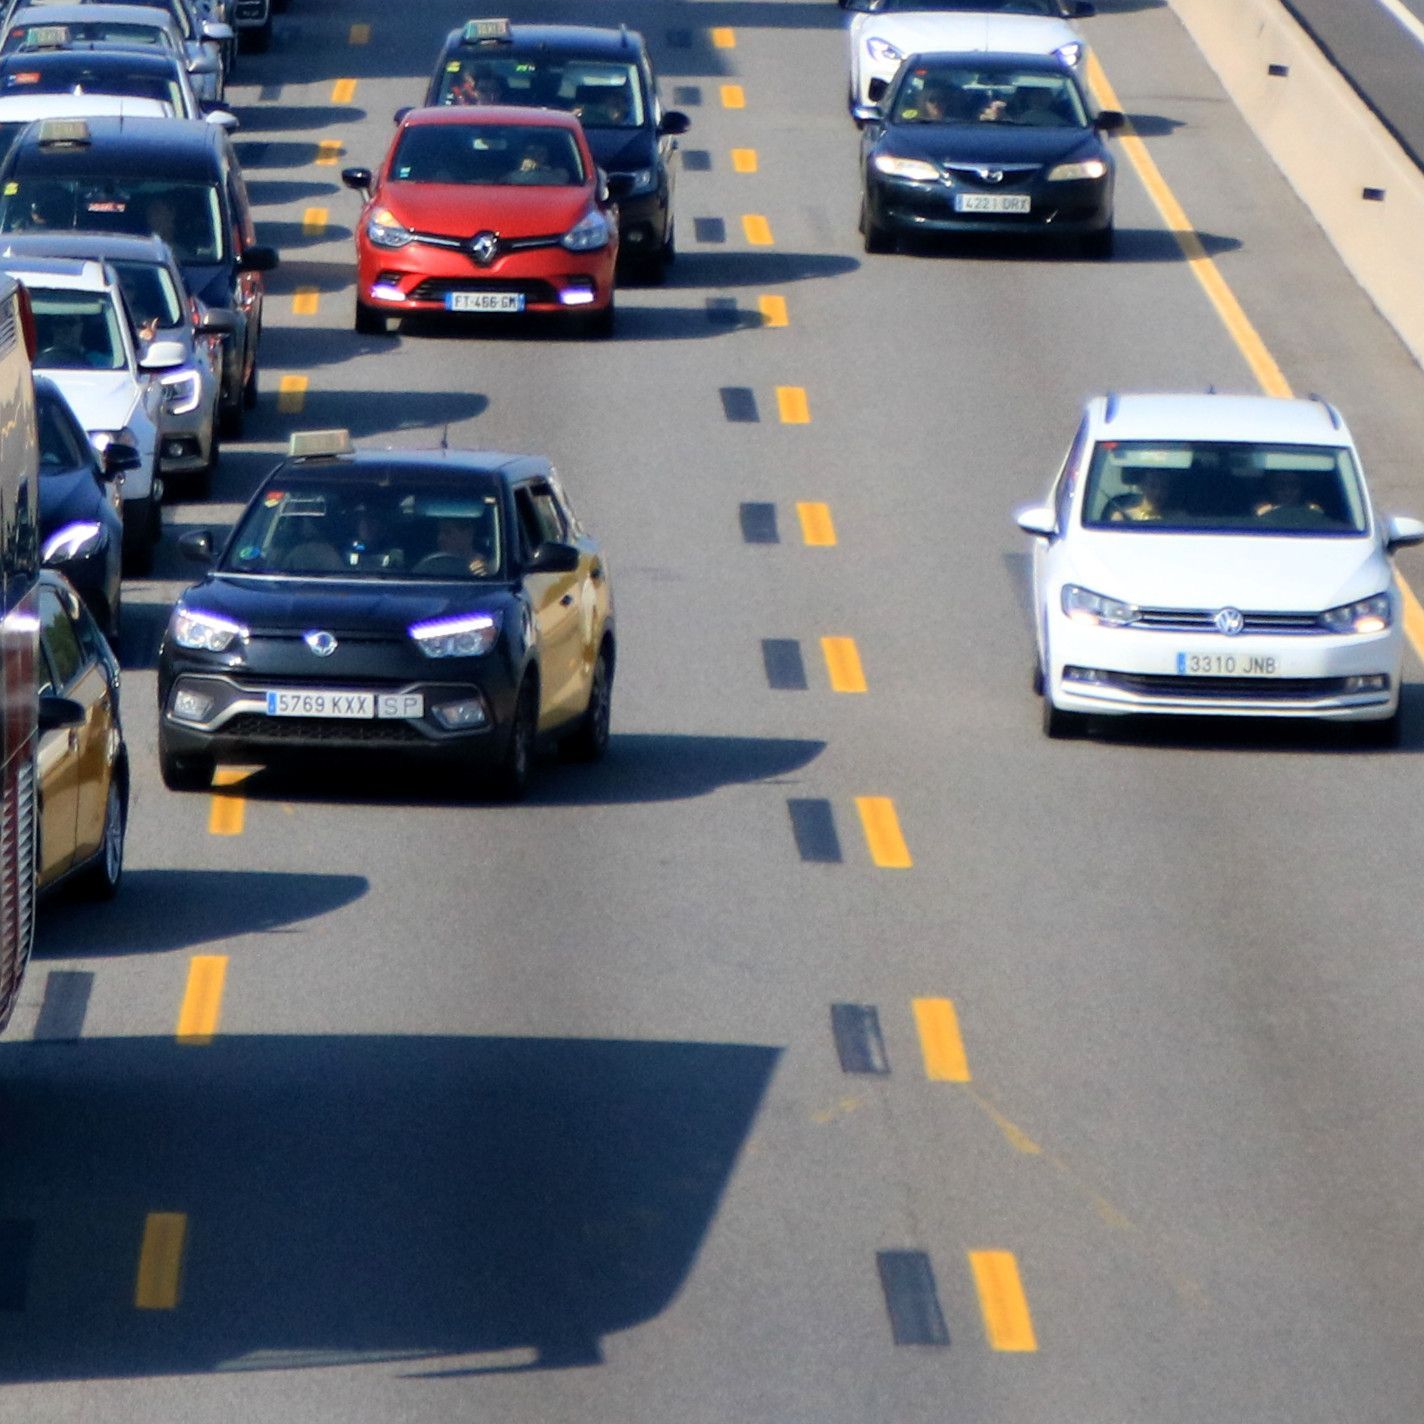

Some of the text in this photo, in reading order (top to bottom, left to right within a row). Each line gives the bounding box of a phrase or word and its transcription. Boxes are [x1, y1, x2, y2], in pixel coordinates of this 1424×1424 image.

[1190, 656, 1277, 674] 3310 JNB
[279, 695, 368, 714] 5769 KXX
